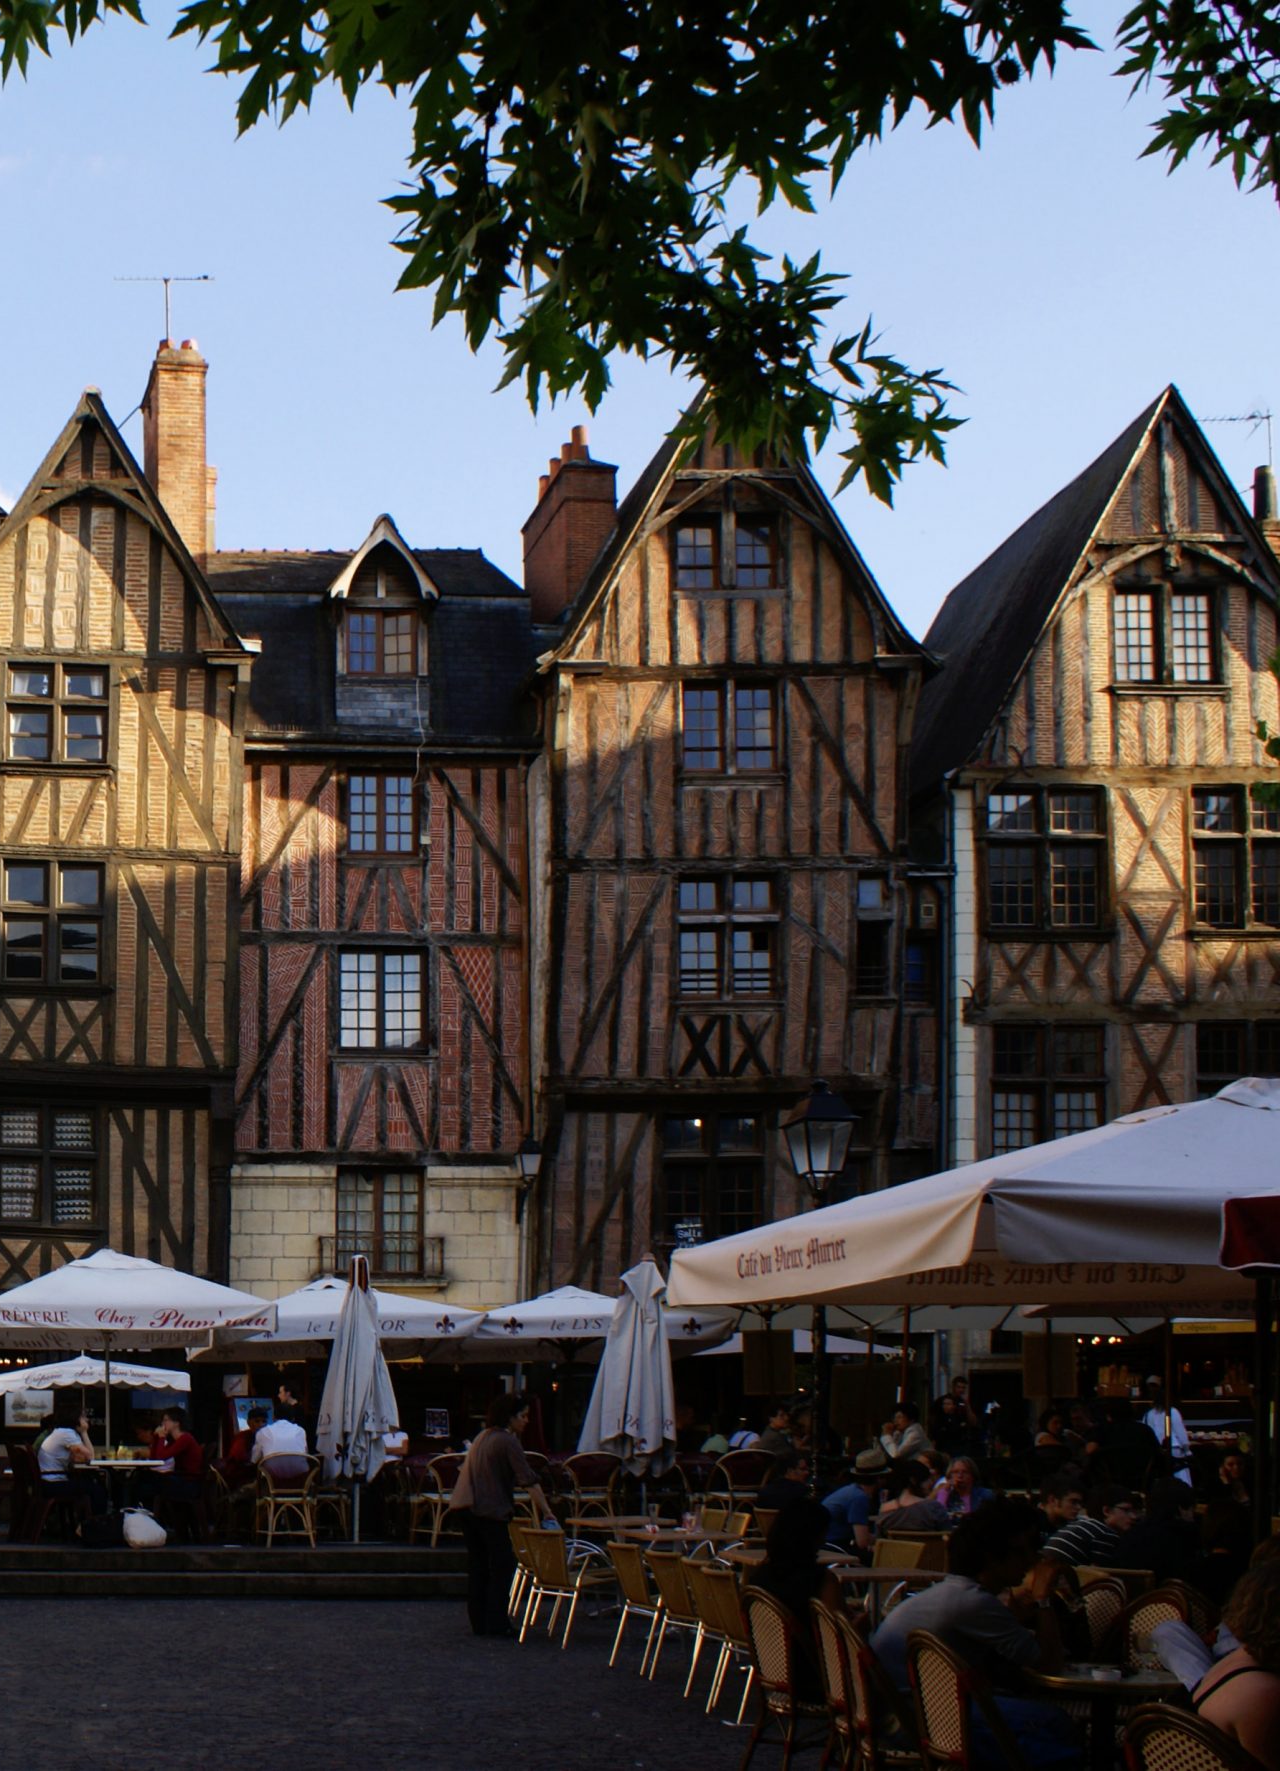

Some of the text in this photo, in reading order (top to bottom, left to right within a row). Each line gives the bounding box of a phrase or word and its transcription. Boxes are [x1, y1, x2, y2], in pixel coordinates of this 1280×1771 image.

[737, 1250, 758, 1279] Café
[94, 1307, 137, 1329] Chez
[571, 1318, 603, 1331] LYS
